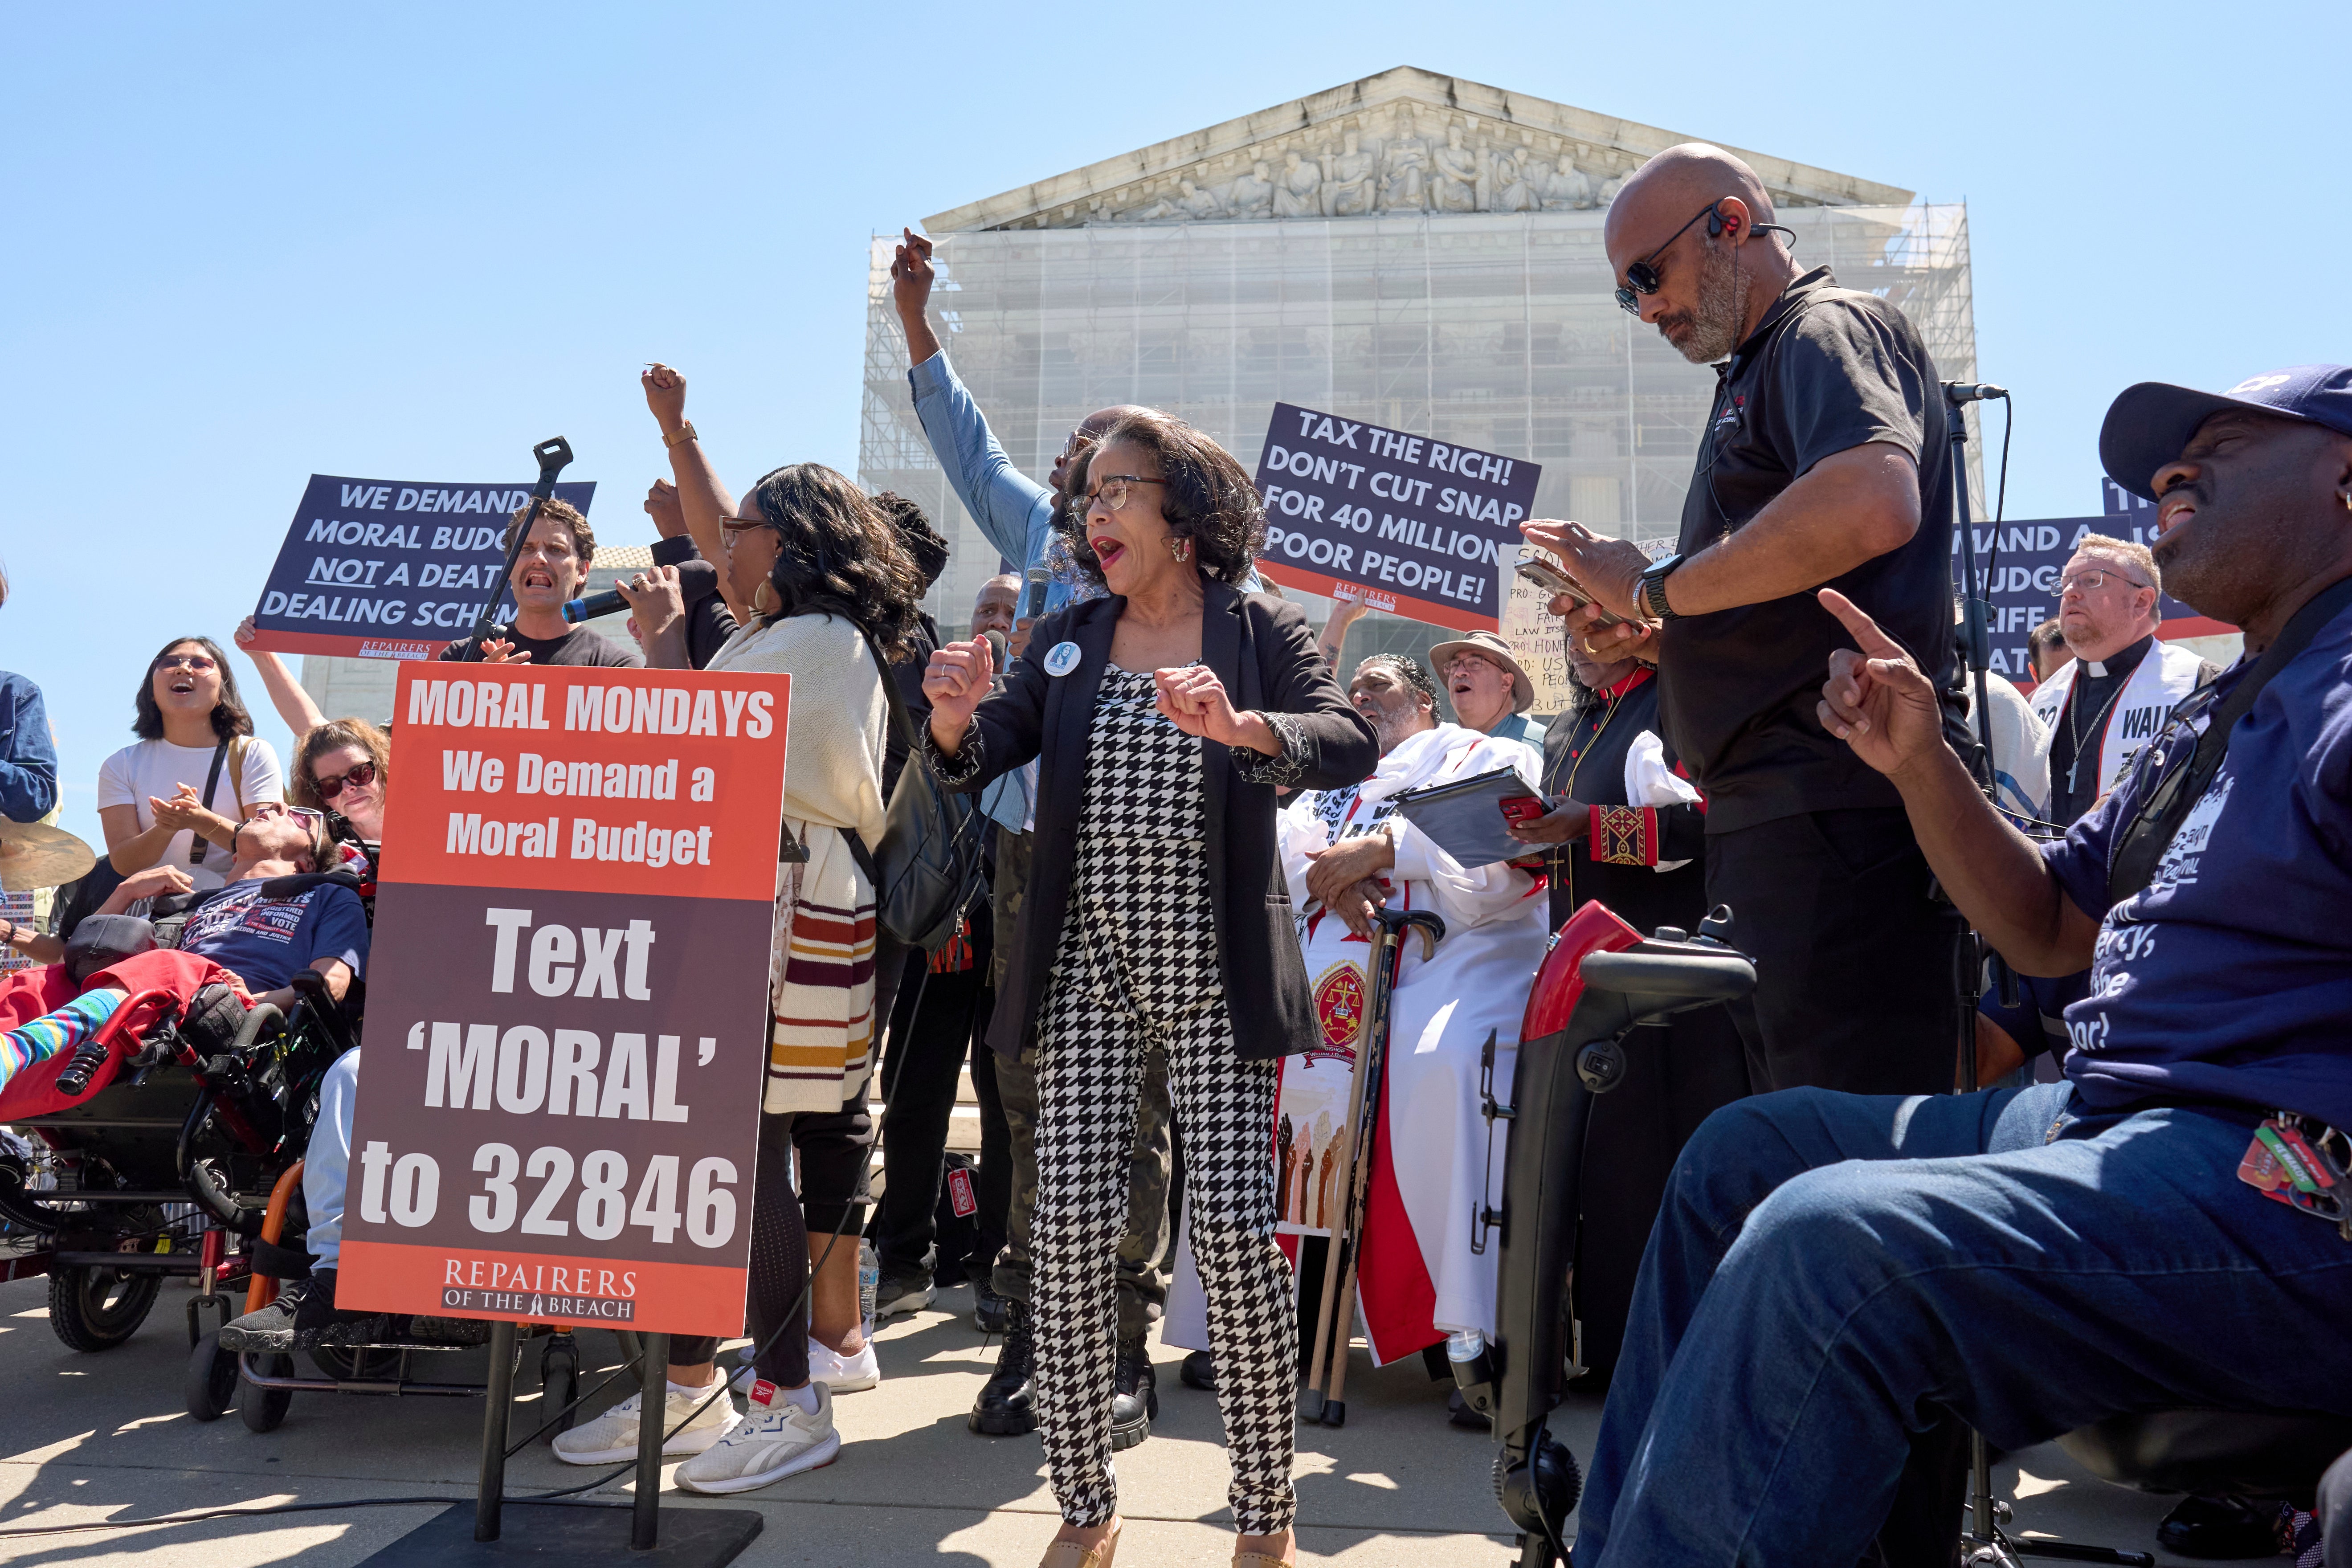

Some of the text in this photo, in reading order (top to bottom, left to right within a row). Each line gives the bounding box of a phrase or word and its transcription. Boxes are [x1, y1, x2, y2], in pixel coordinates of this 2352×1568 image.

[1299, 411, 1513, 486] TAX THE RICH!
[342, 485, 392, 510] WE
[396, 489, 530, 514] DEMAND
[1267, 445, 1523, 527] DON’T CUT SNAP
[306, 519, 505, 551] MORAL BUDG
[1262, 484, 1507, 567] FOR 40 MILLION
[1952, 526, 2061, 555] MAND
[308, 557, 503, 589] NOT A DEAT
[1263, 526, 1486, 604] POOR PEOPLE!
[261, 591, 406, 625] DEALING
[1335, 582, 1397, 604] REPIRERS
[1367, 600, 1394, 611] BREACH
[1511, 588, 1532, 599] PRO:
[1544, 625, 1565, 634] ITSE
[362, 641, 431, 653] REPAIRERS
[1535, 639, 1566, 653] HONE
[1048, 662, 1066, 670] FORWARD
[1543, 673, 1568, 686] PEO
[408, 679, 774, 739] MORAL MONDAYS
[443, 750, 715, 802] We Demand a
[446, 813, 713, 868] Moral Budget
[260, 911, 300, 923] INFORMED
[271, 917, 298, 931] VOTE
[269, 932, 292, 941] JUSTICE
[2094, 924, 2158, 961] erty,
[486, 907, 656, 1001] Text
[1315, 969, 1345, 1000] ACTION MINISTRIES
[407, 1021, 716, 1123] ‘MORAL’
[2273, 1143, 2309, 1182] REWARDS
[360, 1141, 738, 1248] to 32846
[445, 1259, 637, 1297] REPAIRERS
[445, 1289, 632, 1319] OF THE BREACH
[755, 1384, 773, 1394] Reebok
